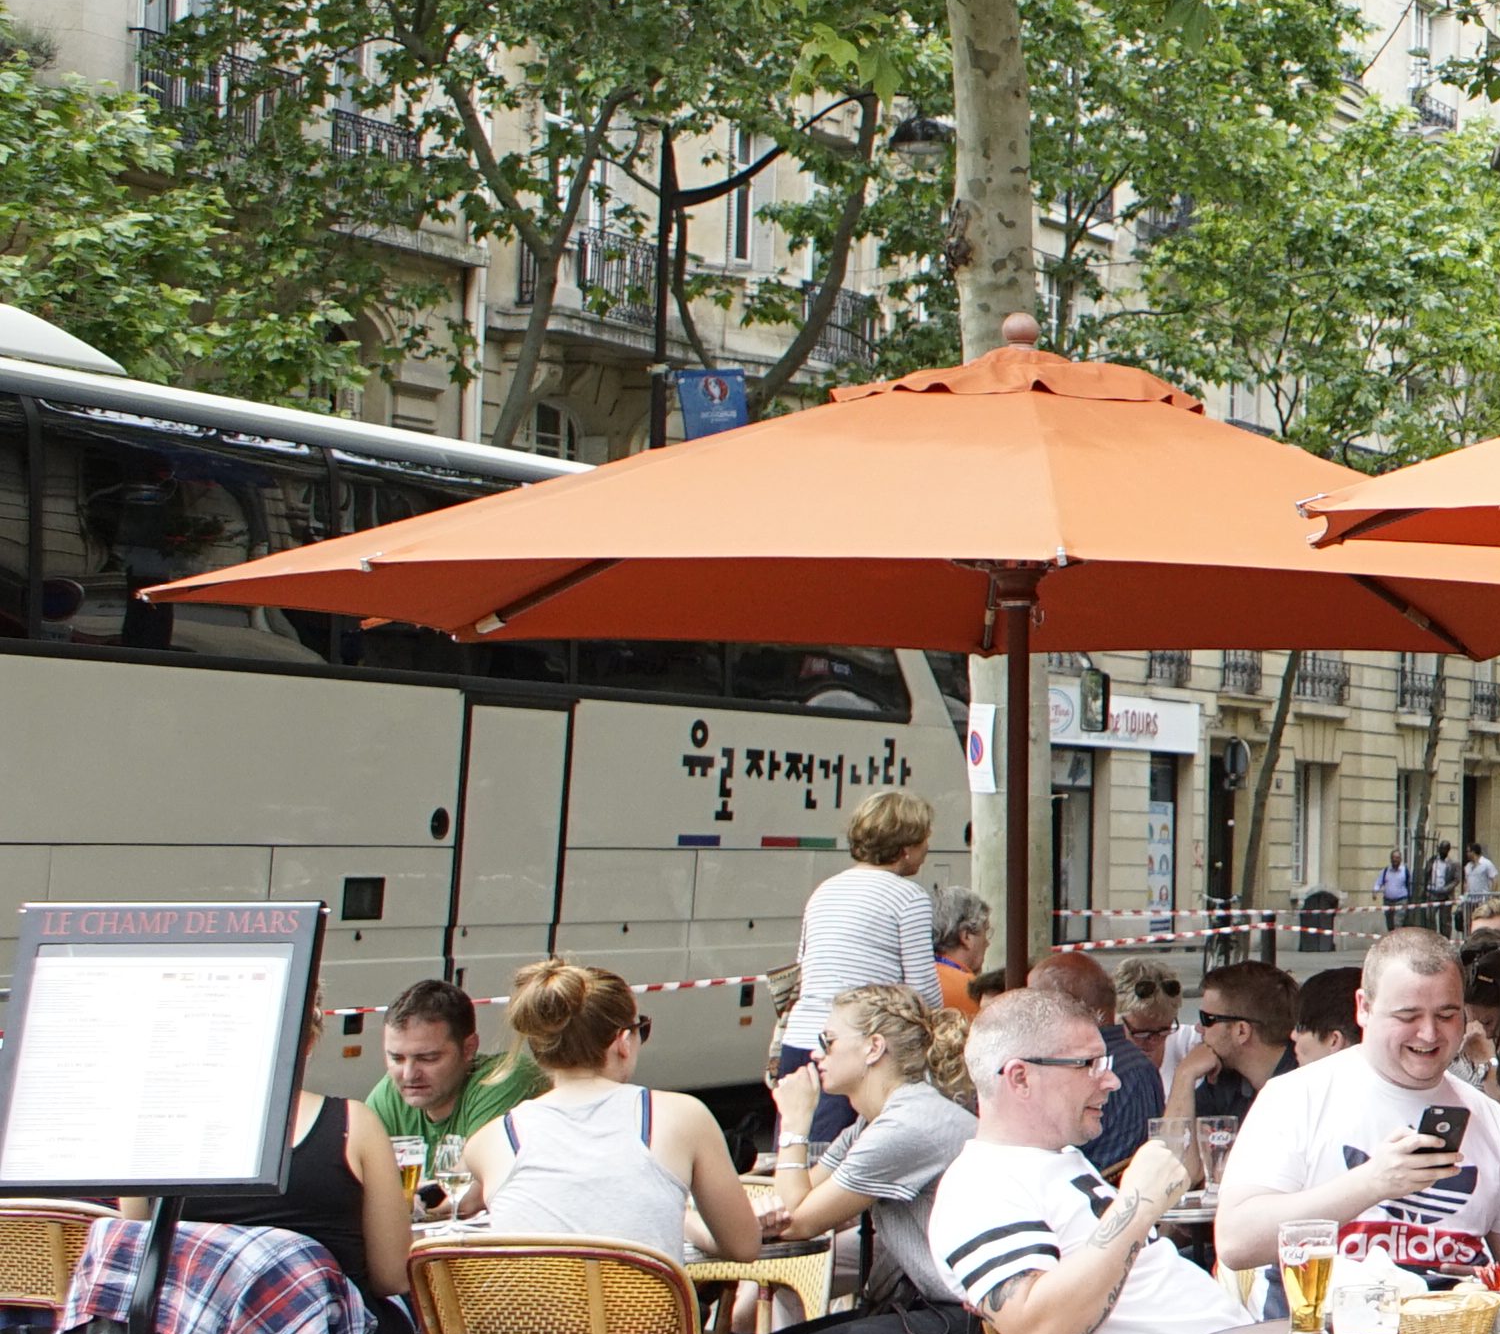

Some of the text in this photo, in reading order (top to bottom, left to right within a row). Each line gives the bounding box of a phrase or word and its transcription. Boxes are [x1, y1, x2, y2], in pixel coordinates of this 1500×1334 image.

[42, 909, 300, 936] LE CHAMP DE MARS
[1339, 1225, 1477, 1264] adidas
